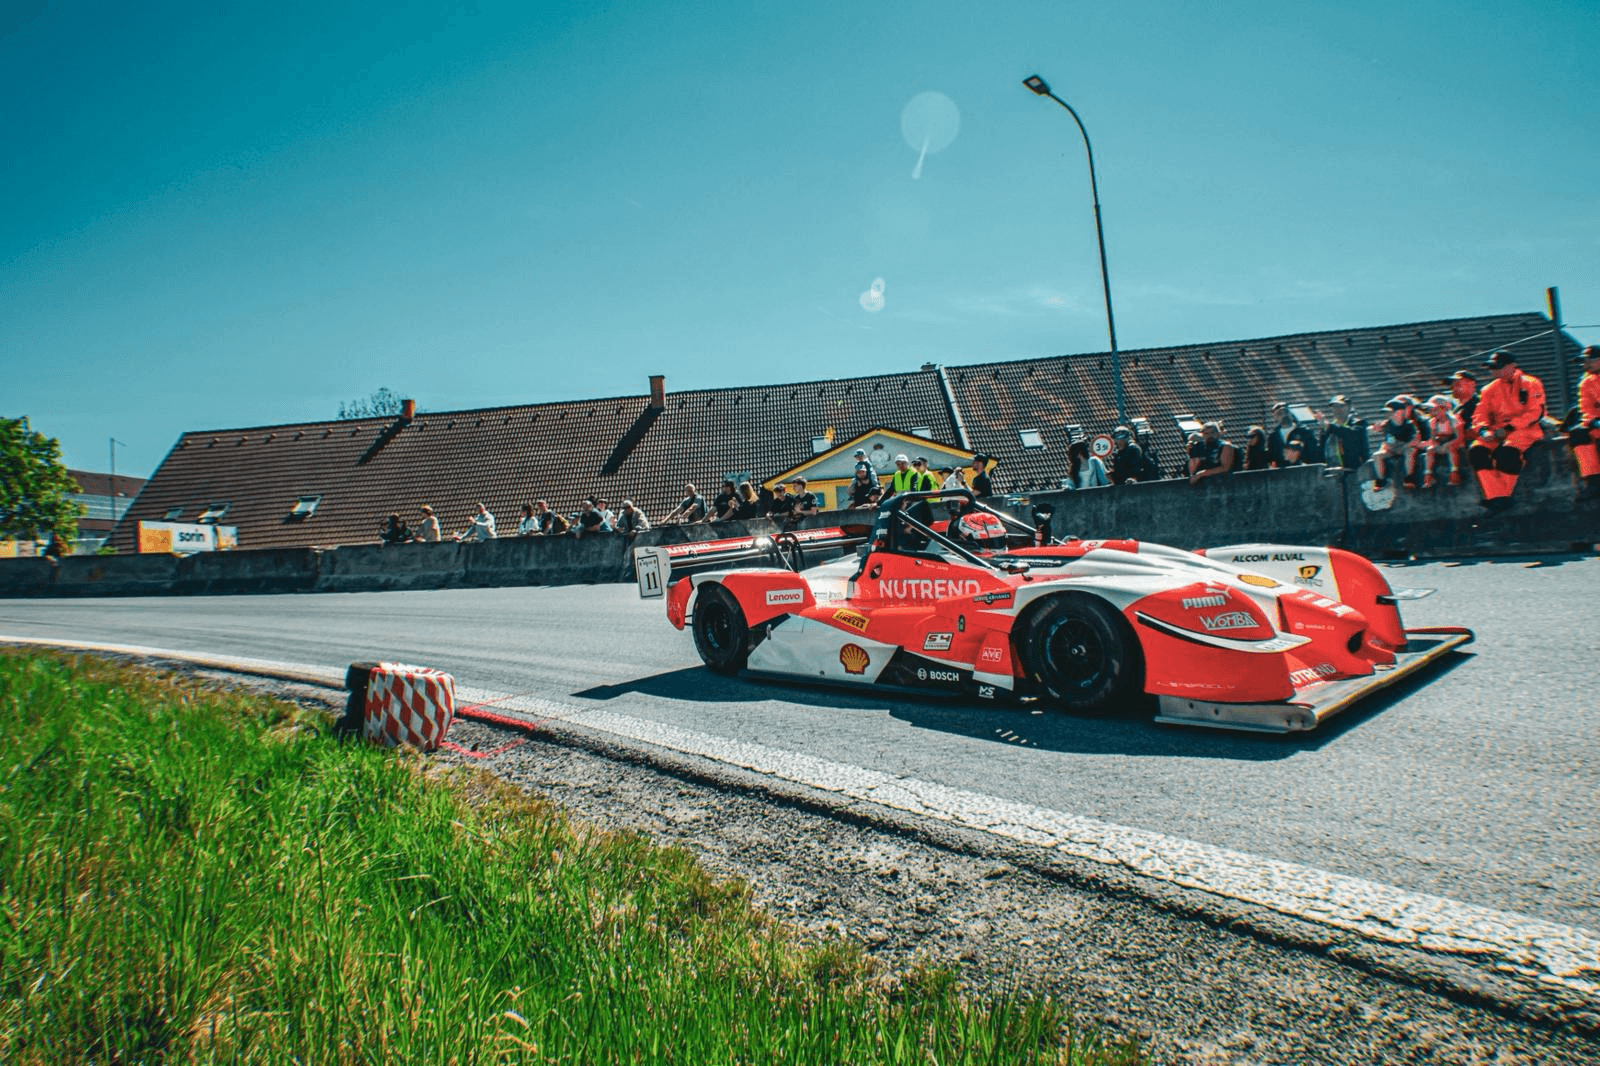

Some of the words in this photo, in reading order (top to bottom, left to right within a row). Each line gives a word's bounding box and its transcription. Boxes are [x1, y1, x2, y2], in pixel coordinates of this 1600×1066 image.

[1231, 554, 1269, 563] ALCOM
[1272, 553, 1305, 561] ALVAL
[645, 571, 659, 590] 11
[768, 593, 801, 601] Lenovo
[879, 579, 981, 600] NUTREND
[1182, 595, 1226, 609] PUMA
[834, 611, 865, 629] PIRELLI
[929, 671, 960, 681] BOSCH
[1288, 663, 1337, 684] UTREND
